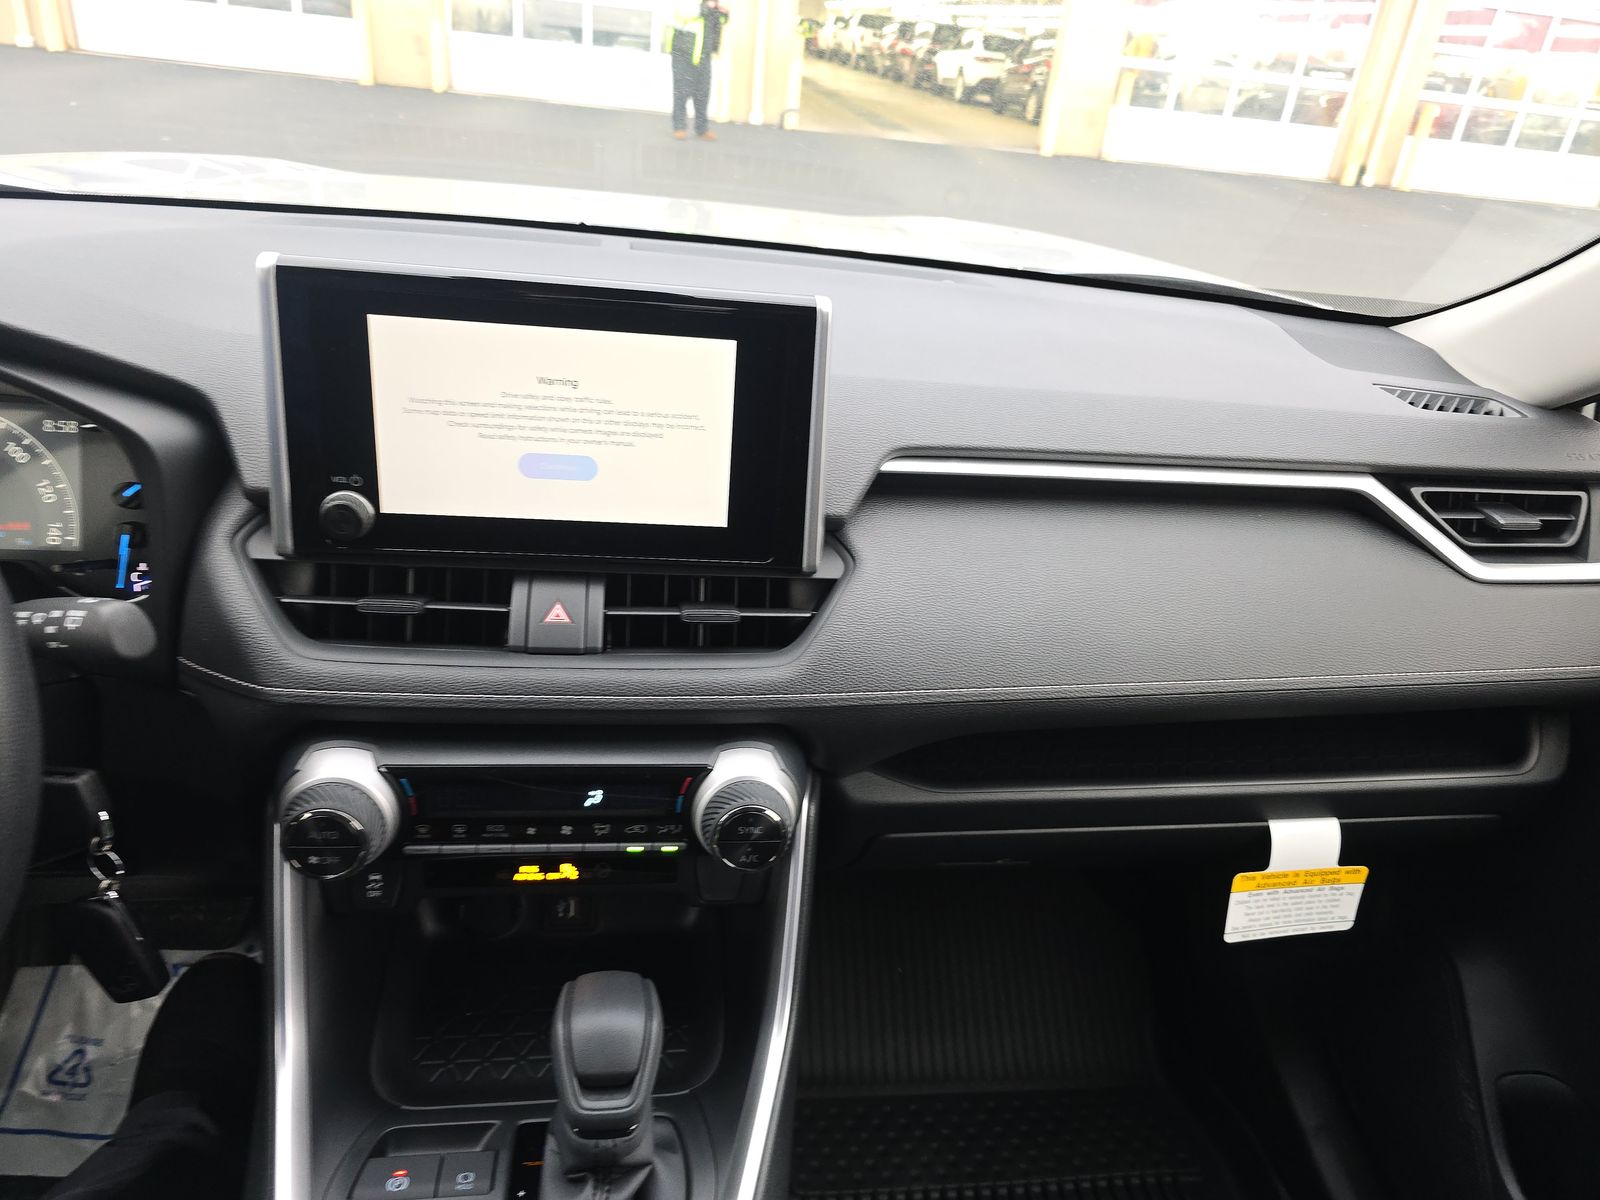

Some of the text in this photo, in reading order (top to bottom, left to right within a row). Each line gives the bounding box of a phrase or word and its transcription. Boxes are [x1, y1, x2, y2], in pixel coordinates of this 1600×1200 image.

[536, 376, 579, 389] Warning
[4, 442, 31, 463] 100
[35, 479, 58, 503] 120
[46, 522, 63, 545] 140
[739, 854, 760, 863] A/C
[1304, 868, 1341, 878] Equipped
